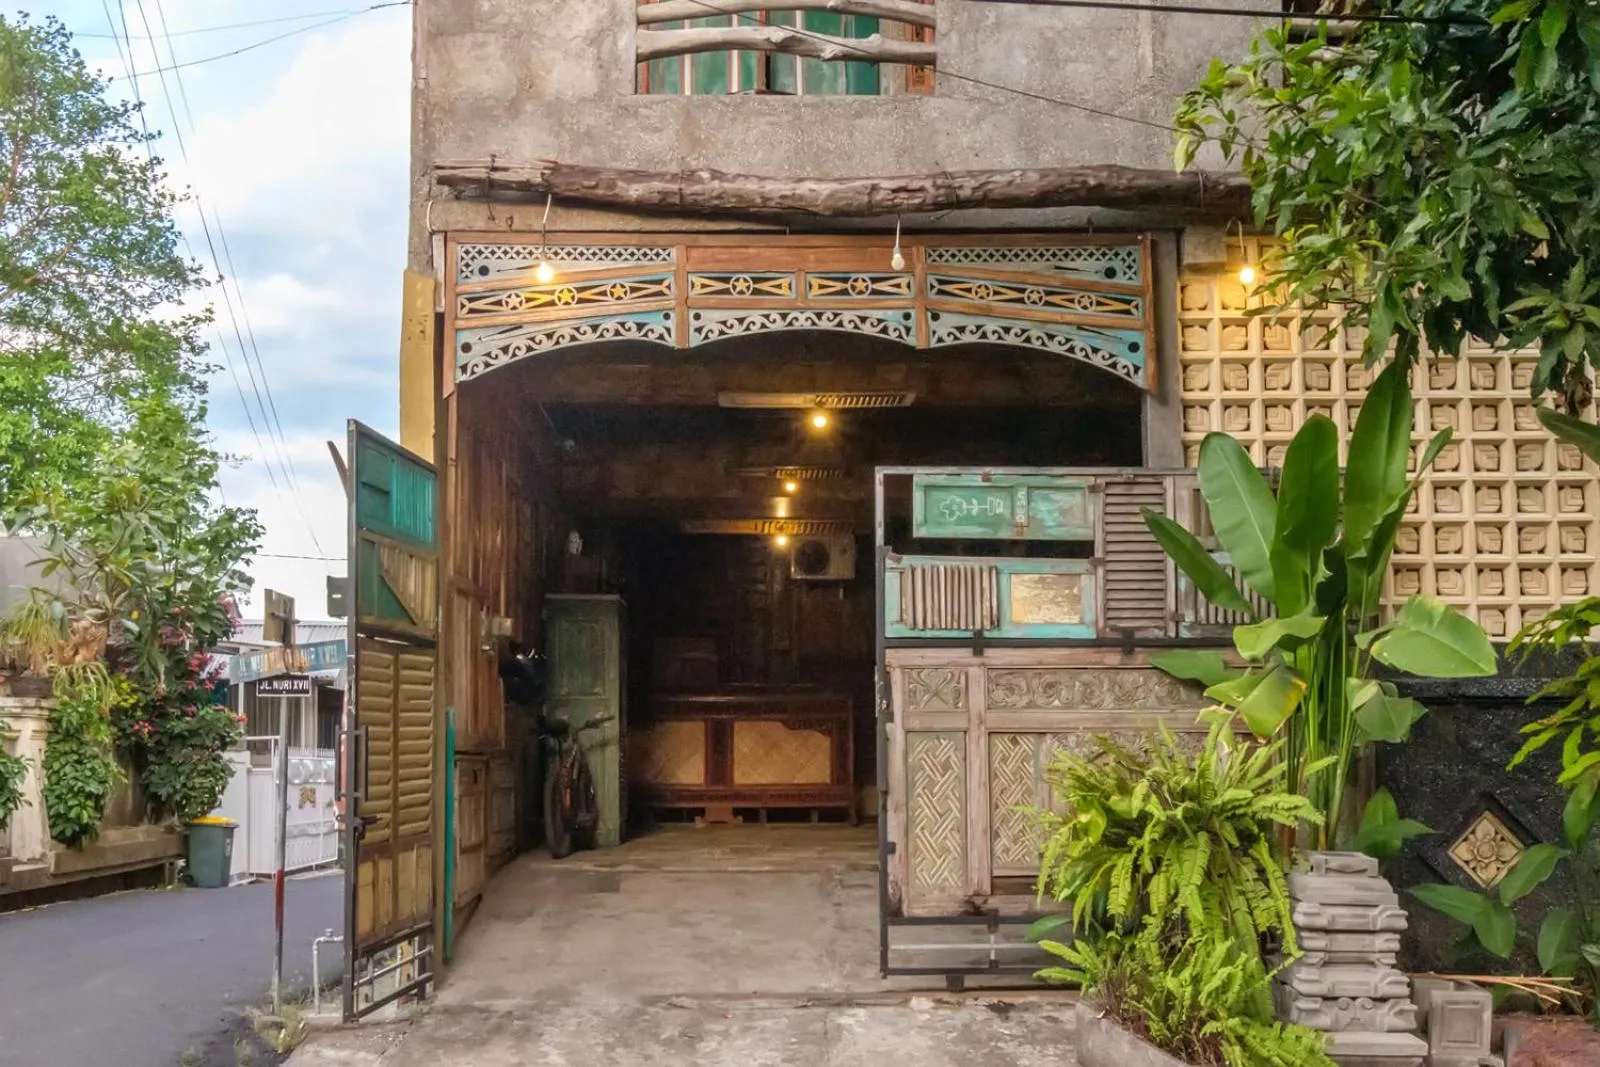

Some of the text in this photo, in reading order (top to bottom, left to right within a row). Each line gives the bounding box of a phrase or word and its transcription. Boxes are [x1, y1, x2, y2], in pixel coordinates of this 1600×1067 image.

[259, 680, 309, 690] JL. NURI XVII
